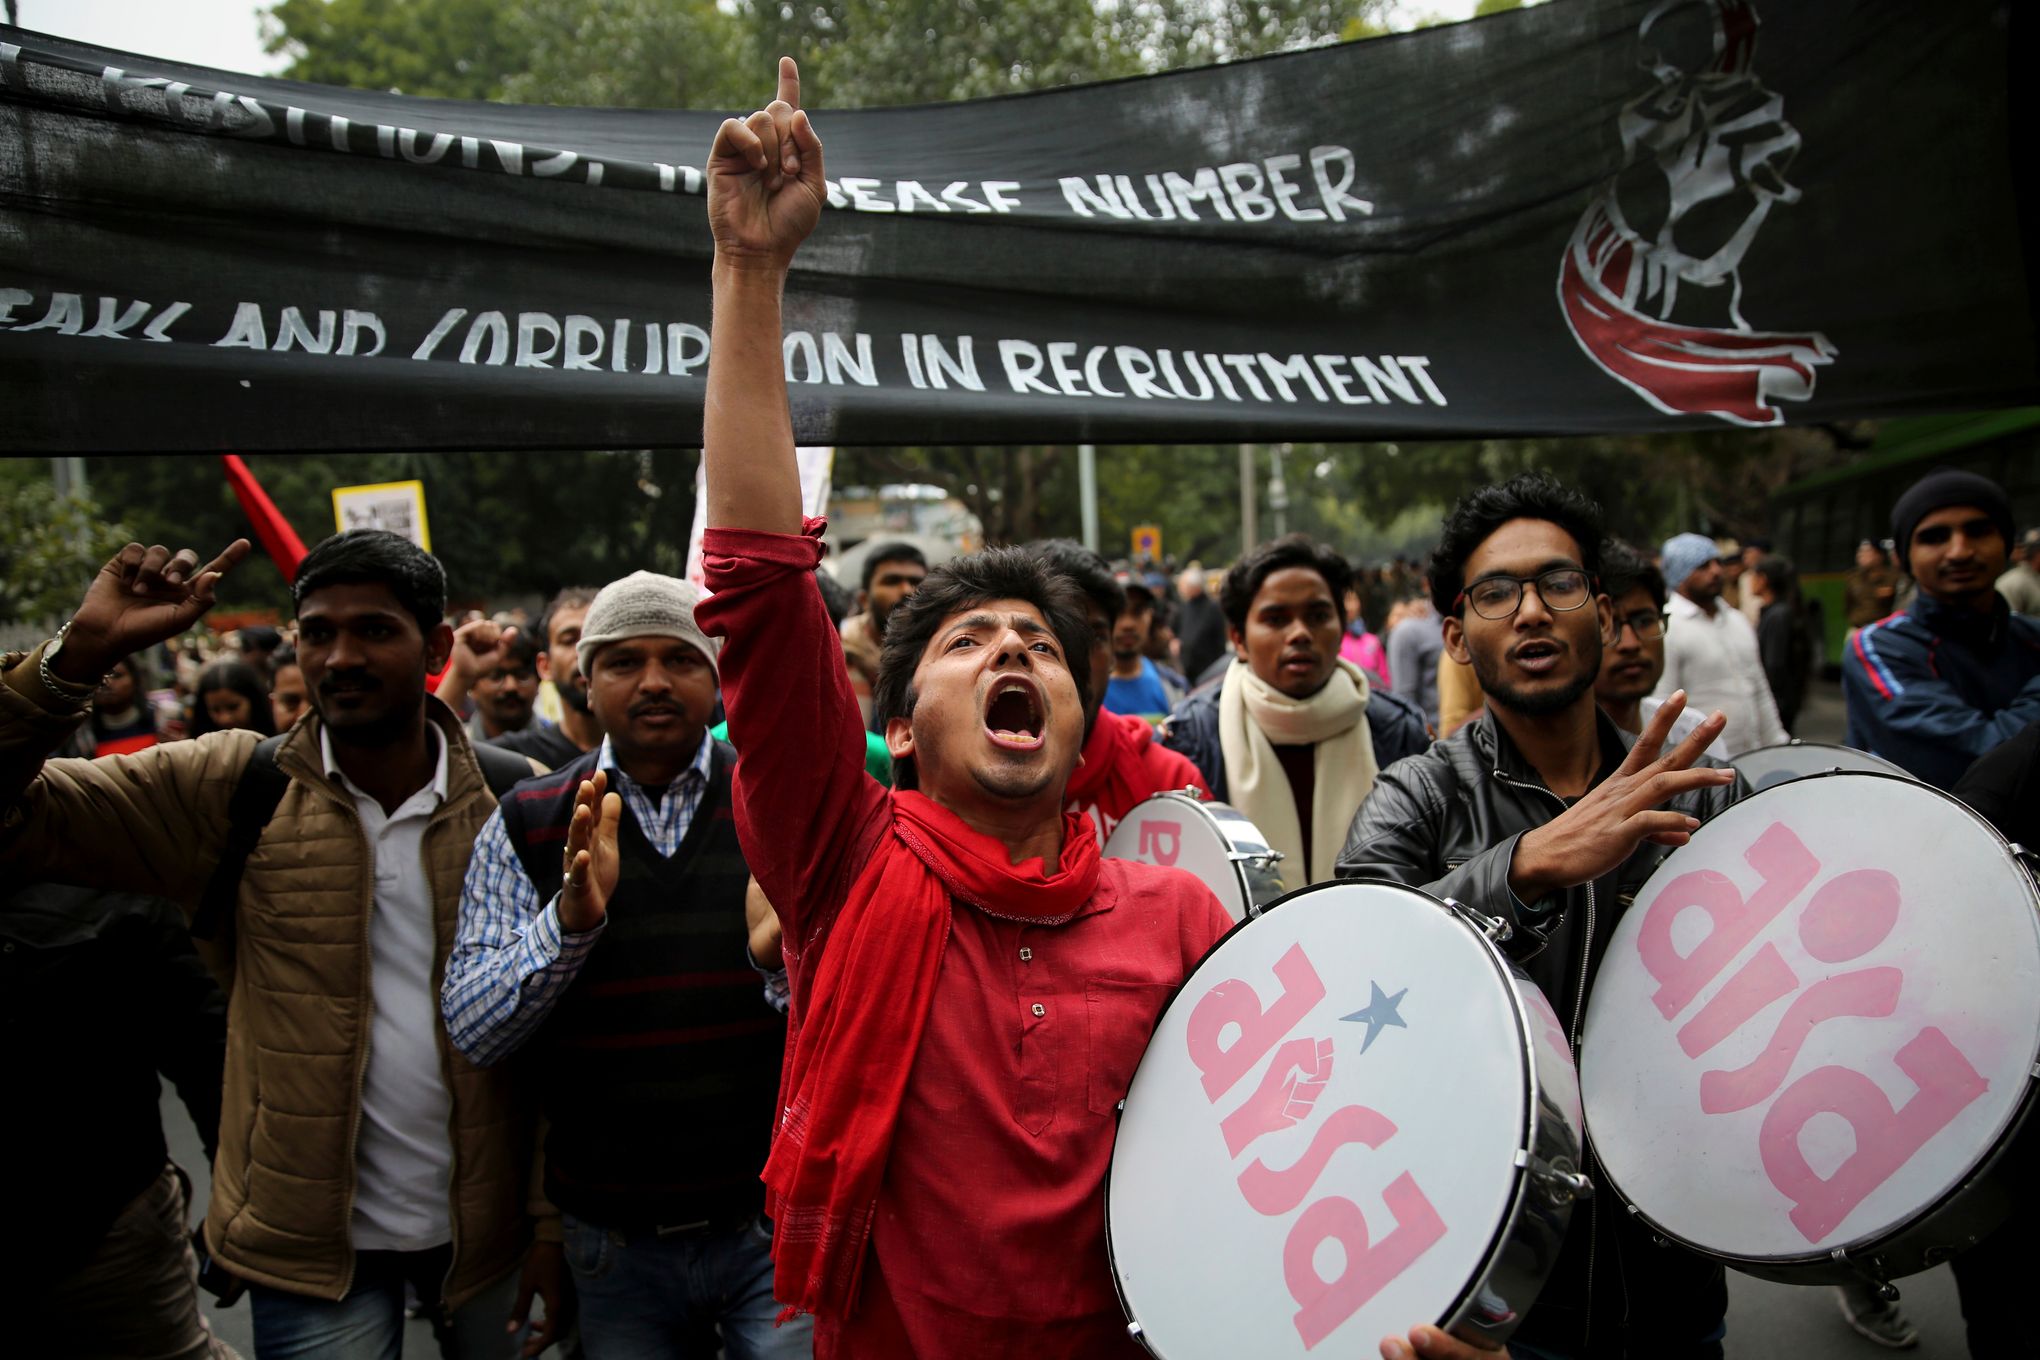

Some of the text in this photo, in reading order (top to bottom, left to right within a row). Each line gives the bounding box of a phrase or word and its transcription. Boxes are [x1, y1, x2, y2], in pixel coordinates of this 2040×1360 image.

[1058, 145, 1374, 222] NUMBER
[208, 301, 387, 356] AND
[411, 308, 880, 386] CORRUPON
[902, 333, 986, 392] IN
[998, 339, 1448, 406] RECRUITMENT
